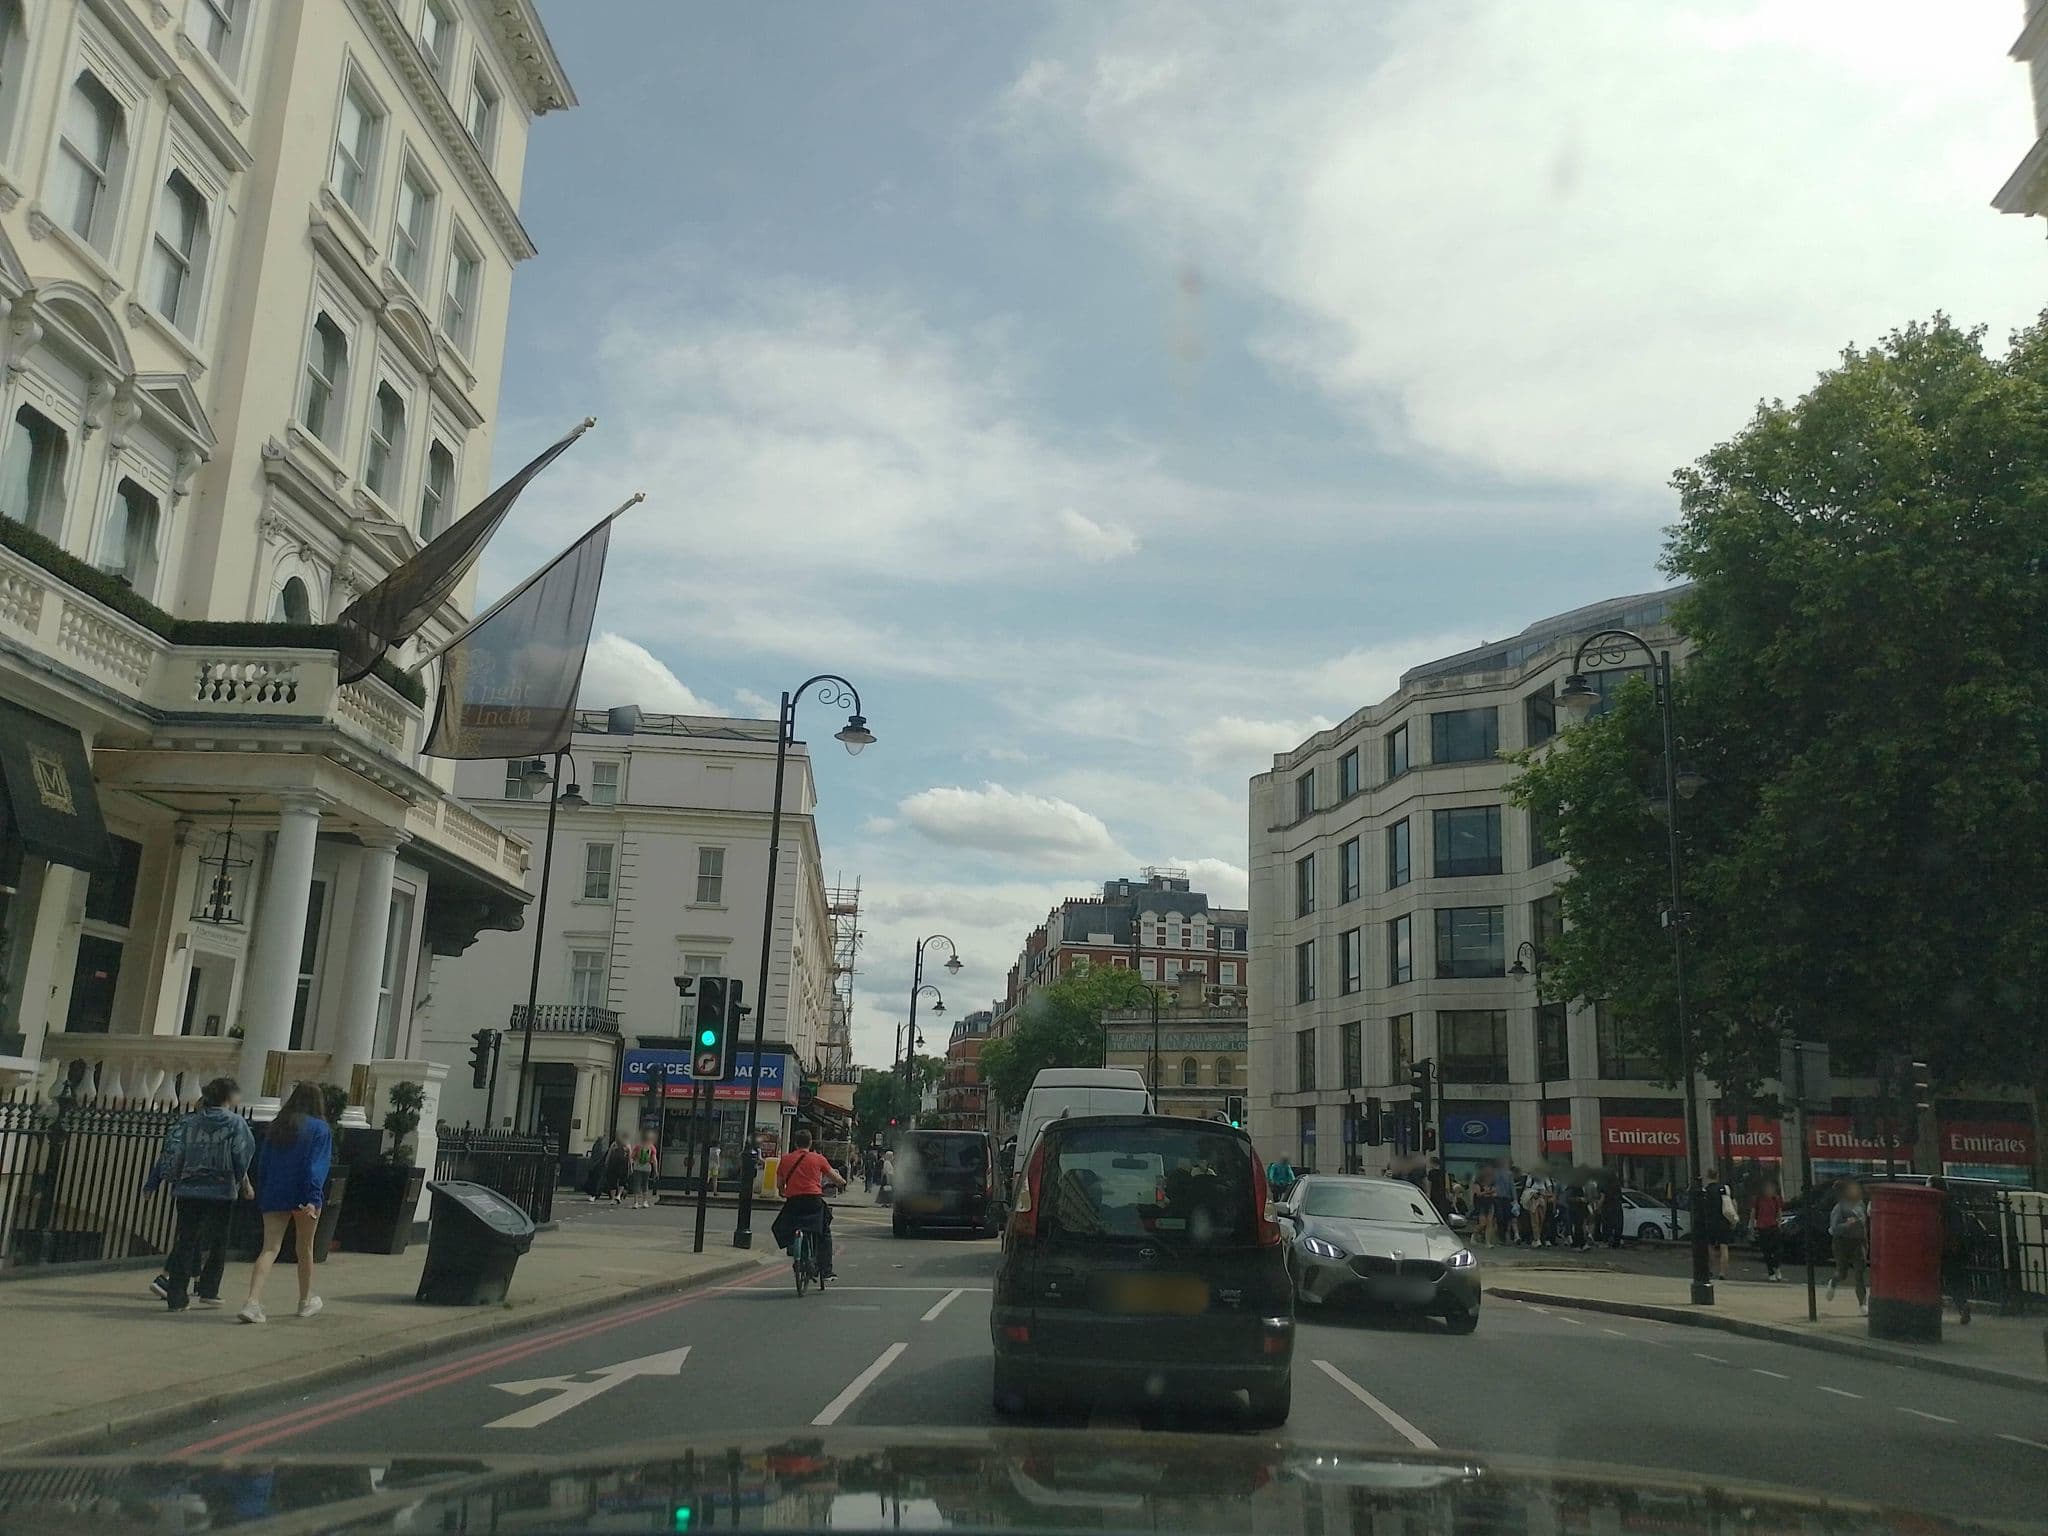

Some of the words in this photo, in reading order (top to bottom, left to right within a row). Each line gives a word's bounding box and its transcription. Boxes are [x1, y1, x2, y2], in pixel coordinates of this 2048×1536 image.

[760, 1067, 777, 1078] FX
[783, 1106, 797, 1114] ATM
[1607, 1128, 1681, 1145] Emirates
[1951, 1133, 2026, 1153] Emirates
